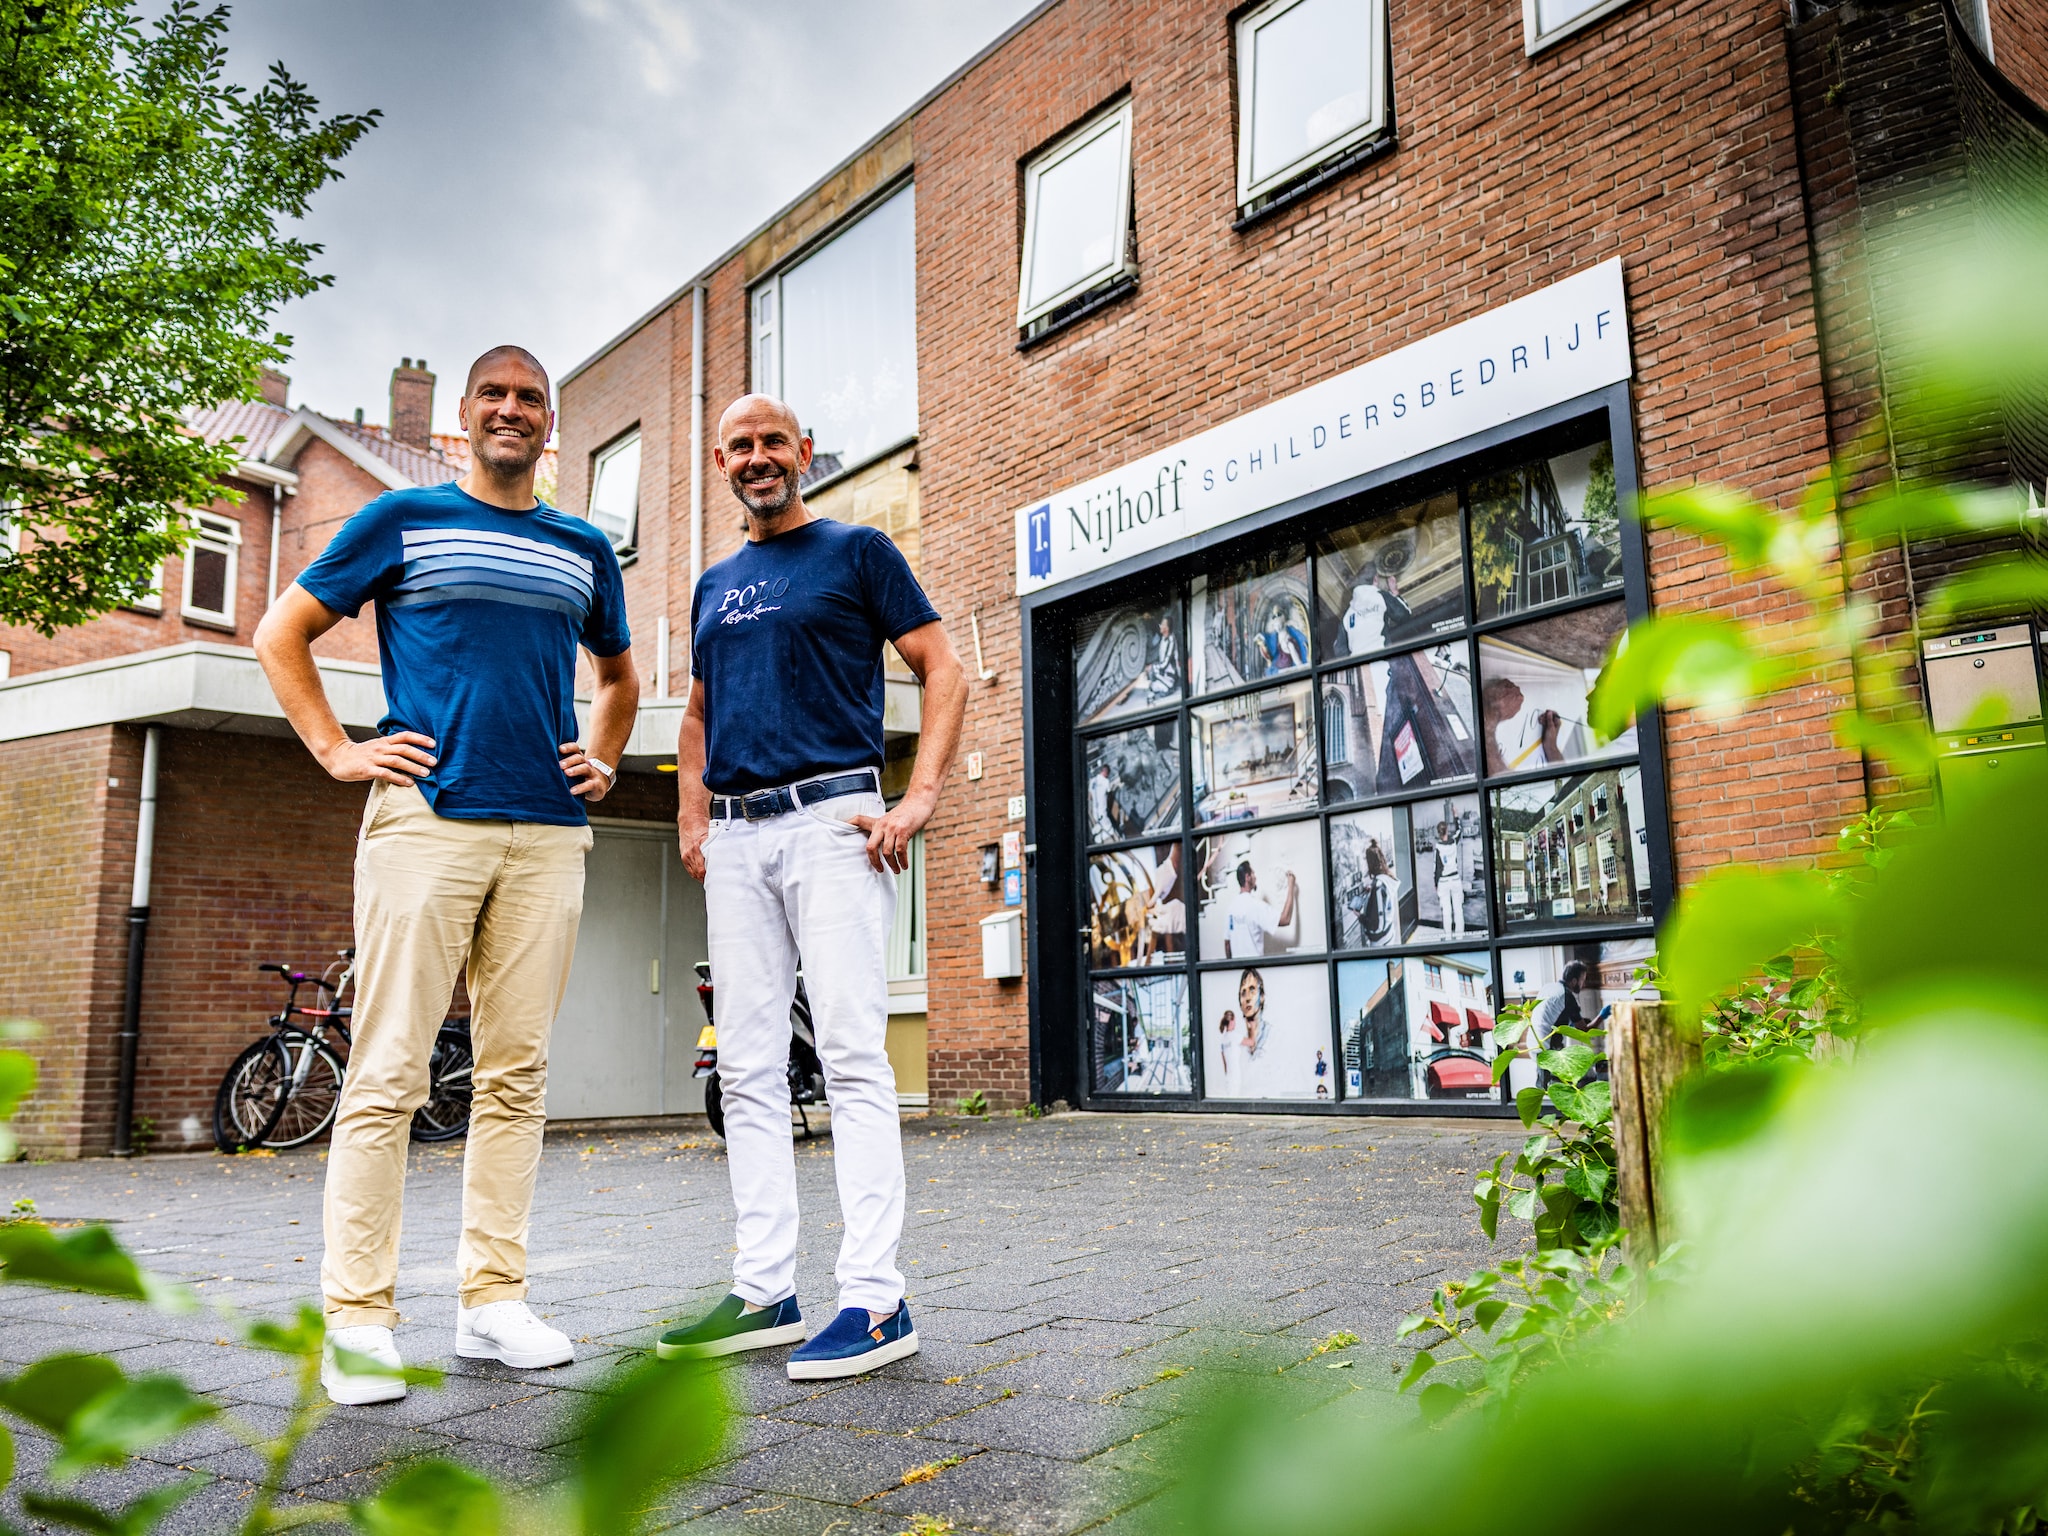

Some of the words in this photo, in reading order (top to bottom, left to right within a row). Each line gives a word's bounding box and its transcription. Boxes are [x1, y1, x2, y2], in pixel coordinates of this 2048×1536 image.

[1067, 459, 1187, 553] Nijhoff
[1203, 310, 1611, 491] SCHILDERSBEDRIJF
[717, 576, 789, 612] POLO
